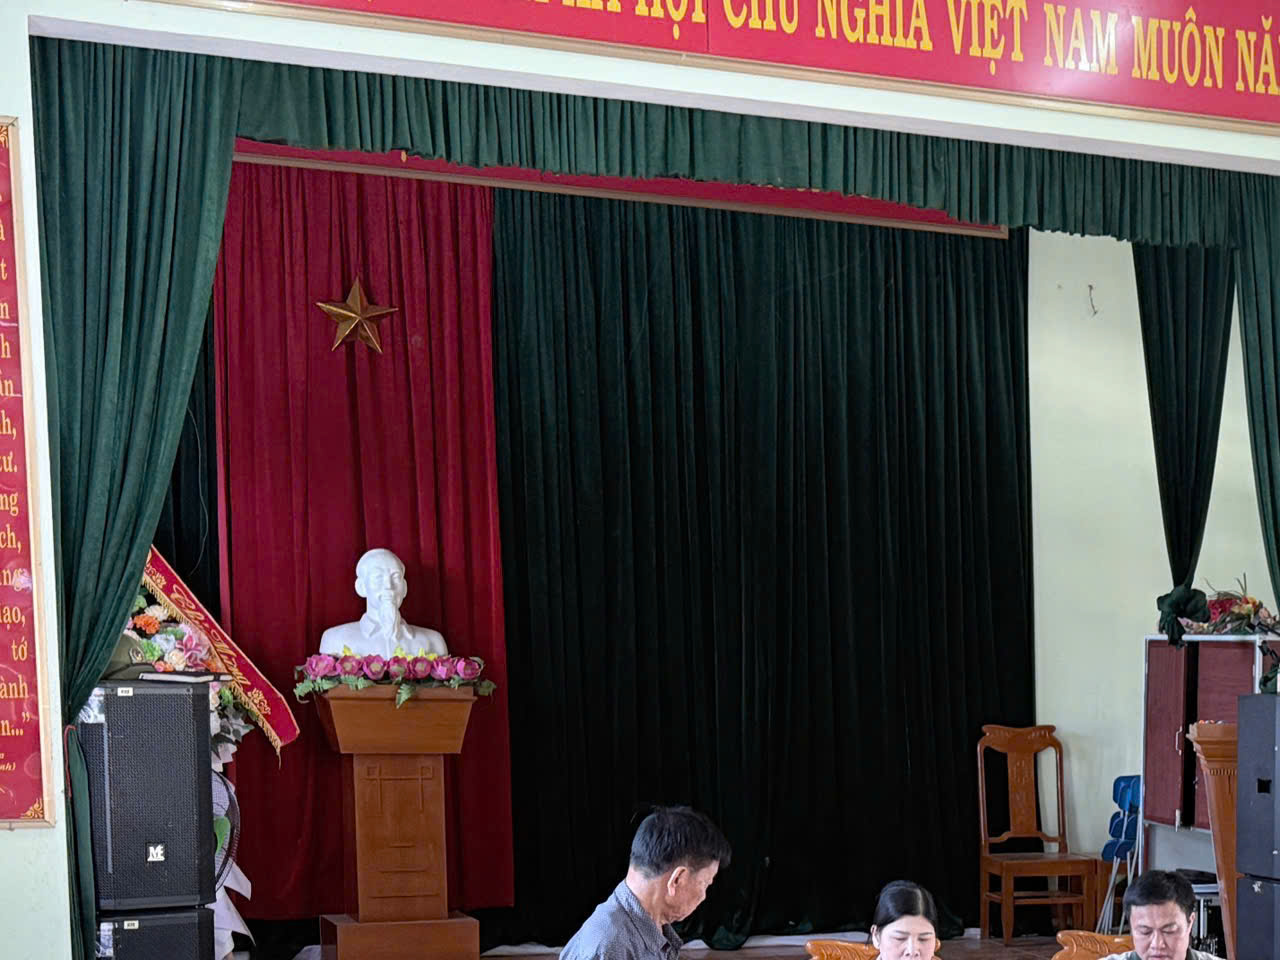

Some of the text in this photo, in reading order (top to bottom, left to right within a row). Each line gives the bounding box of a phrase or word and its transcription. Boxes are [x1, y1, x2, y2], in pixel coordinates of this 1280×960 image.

[1044, 3, 1118, 75] NAM
[1132, 6, 1224, 89] MUÔN
[11, 635, 28, 661] tớ
